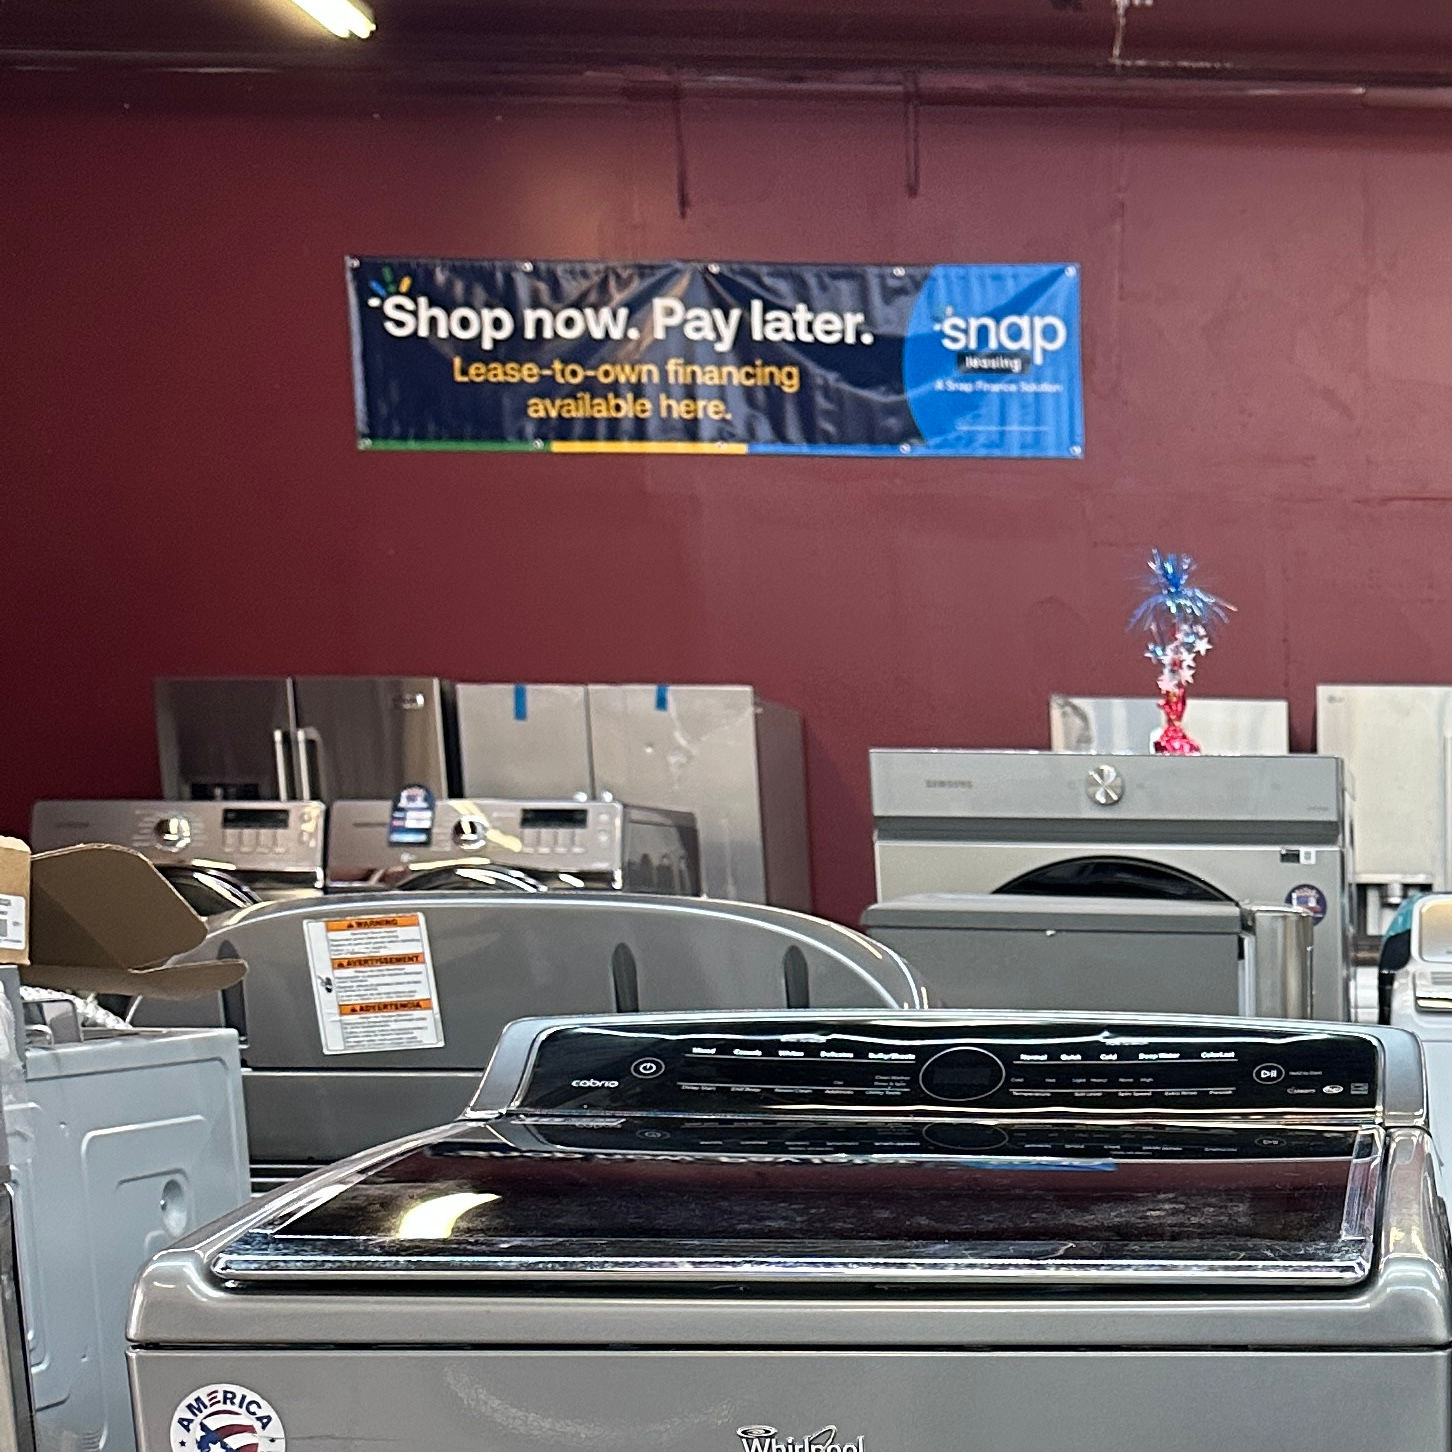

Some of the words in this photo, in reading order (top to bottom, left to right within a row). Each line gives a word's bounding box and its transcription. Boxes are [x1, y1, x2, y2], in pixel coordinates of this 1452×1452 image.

[383, 295, 515, 351] Shop
[523, 306, 640, 341] now.
[652, 296, 742, 353] Pay
[750, 299, 875, 346] later.
[941, 314, 1068, 366] snap
[453, 355, 660, 385] Lease-to-own
[666, 357, 800, 394] financing
[965, 355, 1023, 374] leasing
[527, 391, 652, 419] available
[659, 392, 733, 421] here.
[355, 918, 398, 929] WARNING
[346, 955, 420, 968] AVERTISSEMENT
[571, 1078, 620, 1088] cabrio
[177, 1389, 273, 1434] AMERICA
